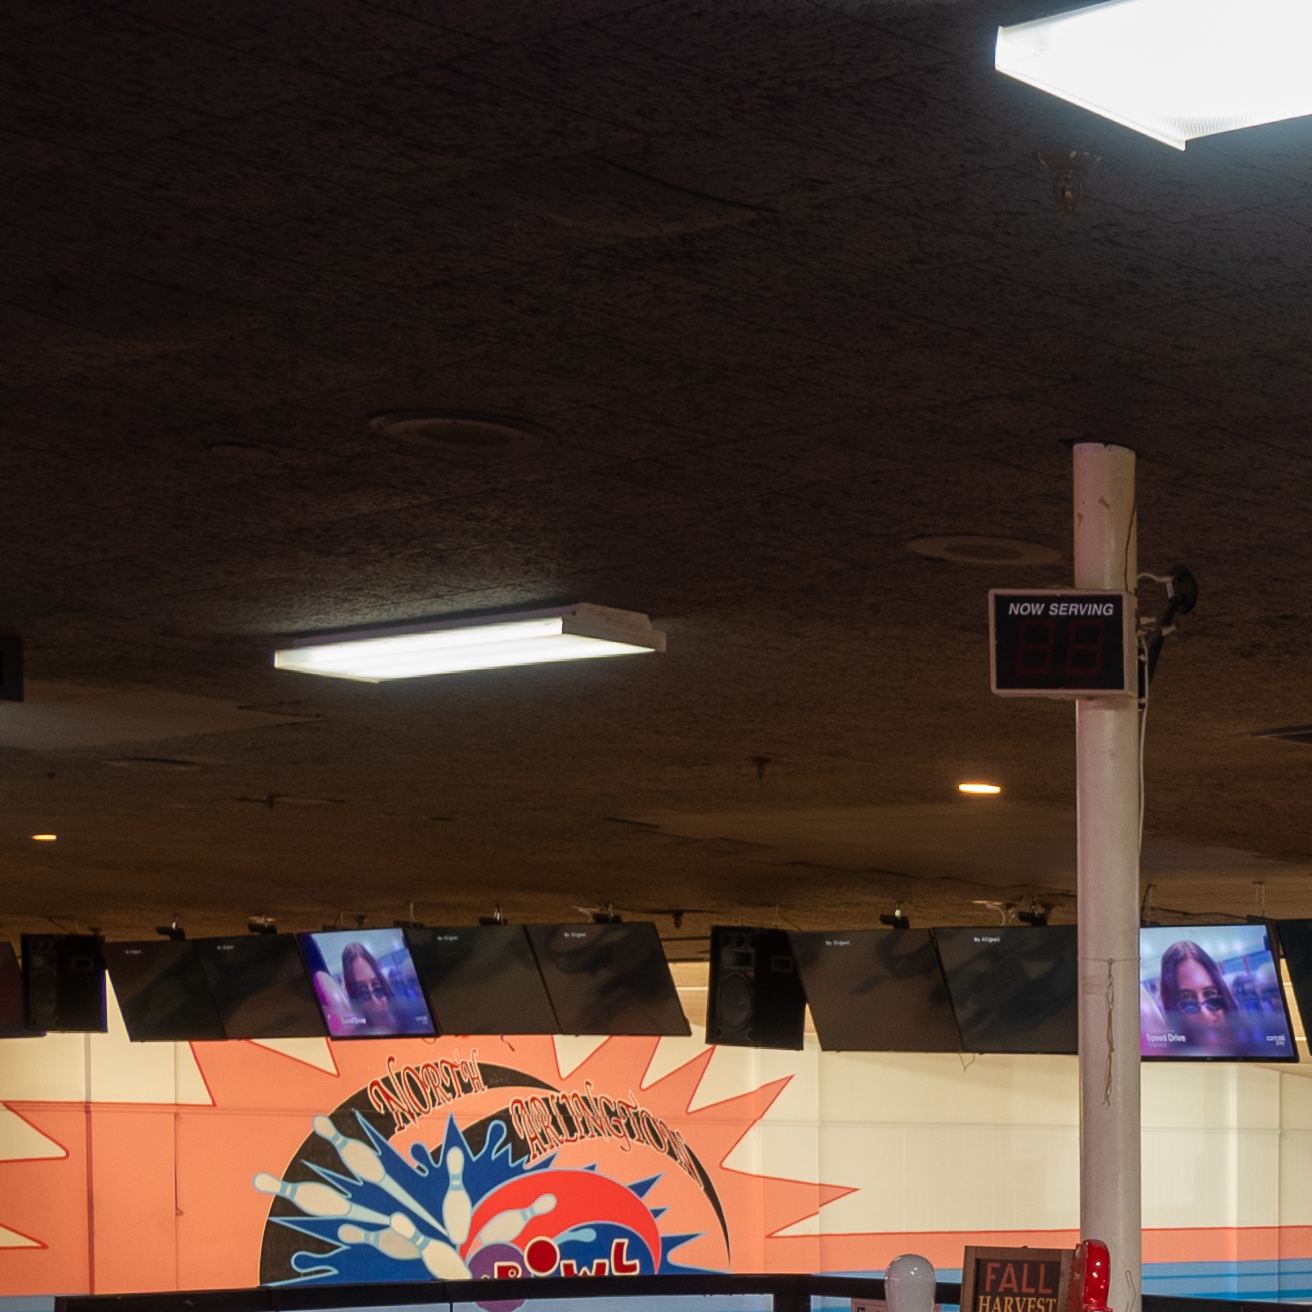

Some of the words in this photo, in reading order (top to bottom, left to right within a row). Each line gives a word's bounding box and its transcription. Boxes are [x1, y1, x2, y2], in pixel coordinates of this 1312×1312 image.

[368, 1047, 488, 1134] NORTH
[509, 1081, 704, 1191] ARLINGTON
[985, 1263, 1052, 1293] FALL
